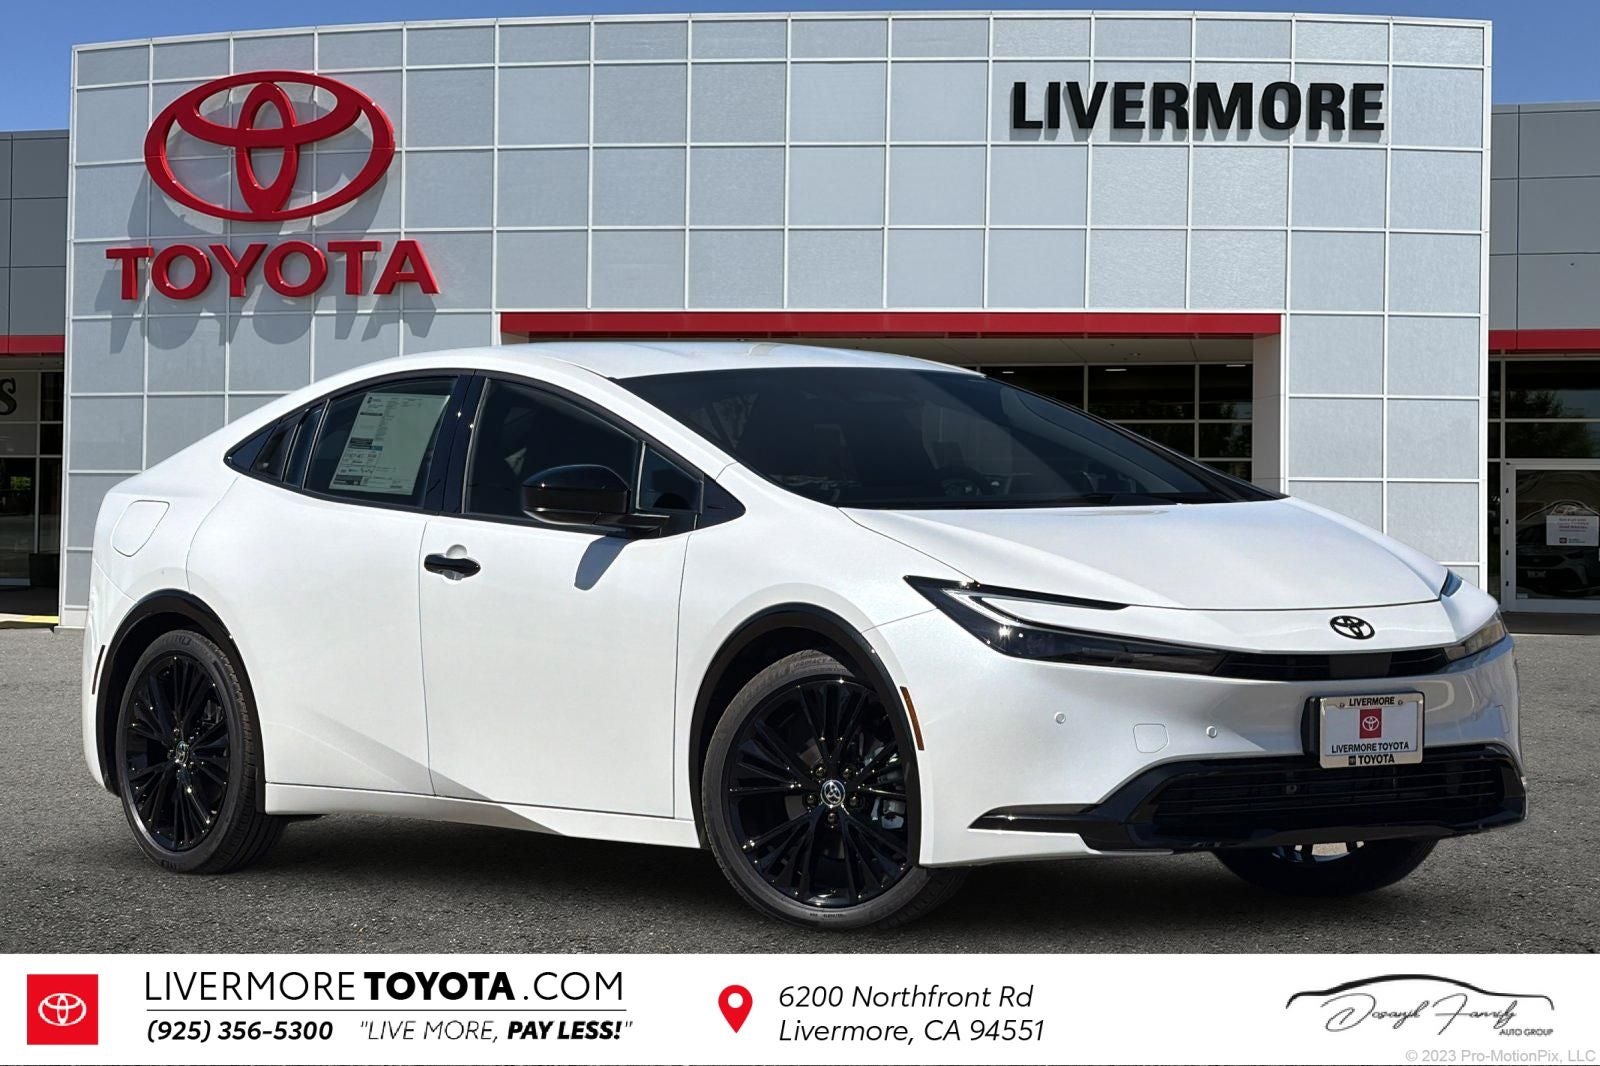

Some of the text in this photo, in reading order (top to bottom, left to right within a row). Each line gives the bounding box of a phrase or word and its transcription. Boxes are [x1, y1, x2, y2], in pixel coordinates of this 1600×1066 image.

[1013, 81, 1385, 131] LIVERMORE
[106, 240, 439, 300] TOYOTA
[1349, 696, 1395, 706] LIVERMORE
[1331, 741, 1410, 754] LIVERMORE TOYOTA
[1358, 754, 1395, 765] TOYOTA
